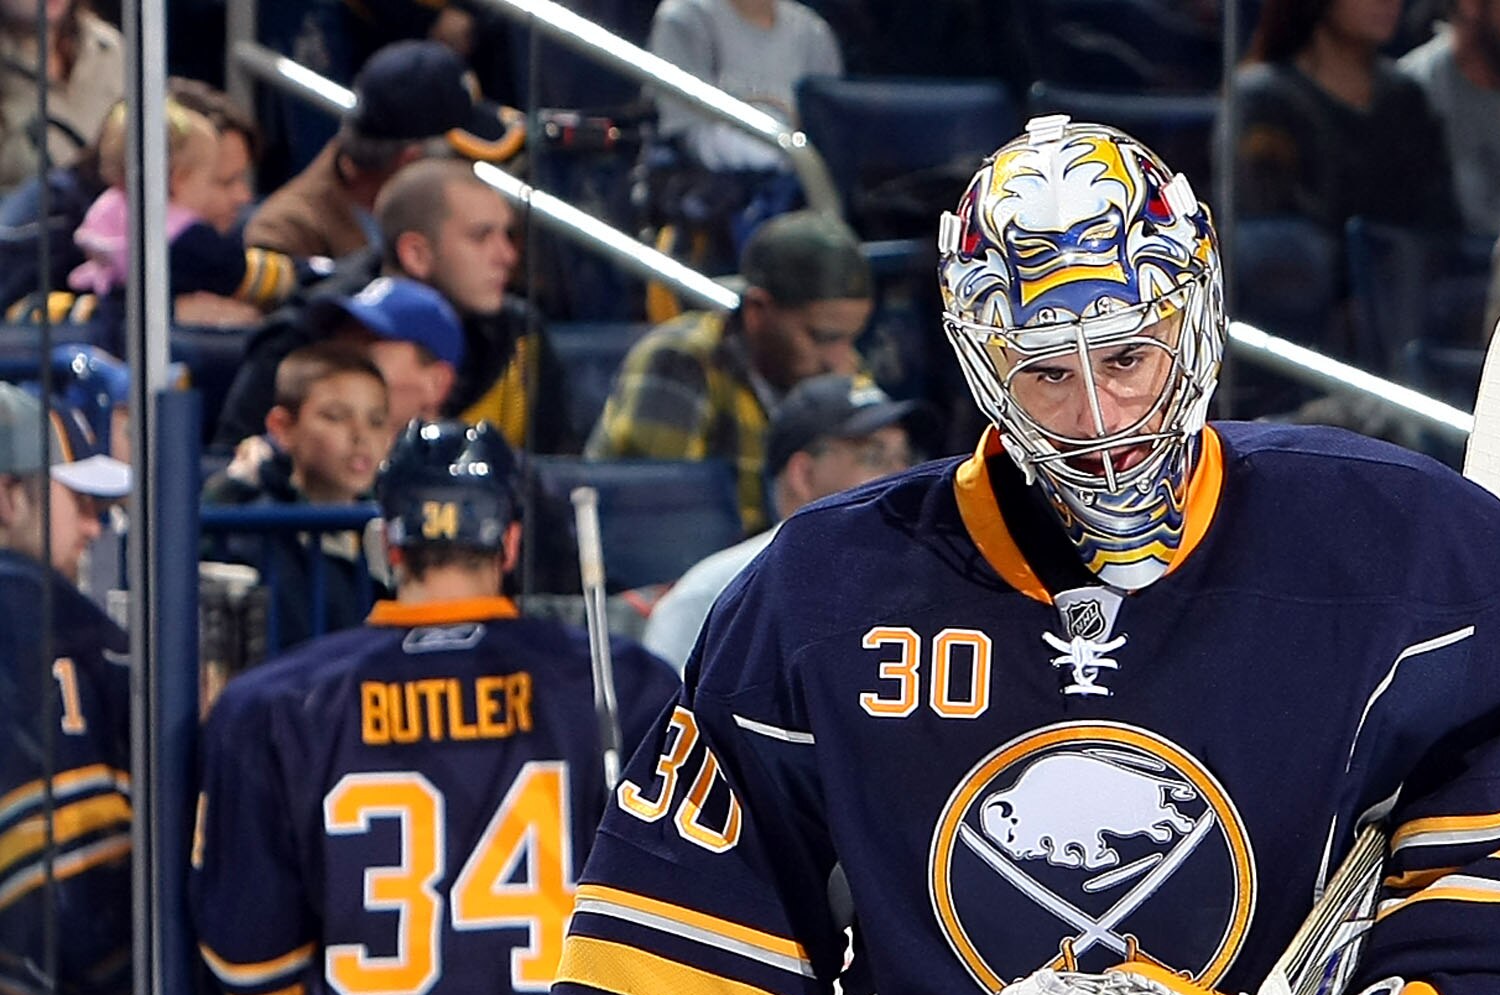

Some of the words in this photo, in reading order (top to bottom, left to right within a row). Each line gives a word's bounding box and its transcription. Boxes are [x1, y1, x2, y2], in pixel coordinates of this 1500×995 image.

[421, 500, 457, 539] 34
[361, 671, 533, 745] BUTLER
[859, 626, 992, 719] 30
[616, 705, 742, 853] 30
